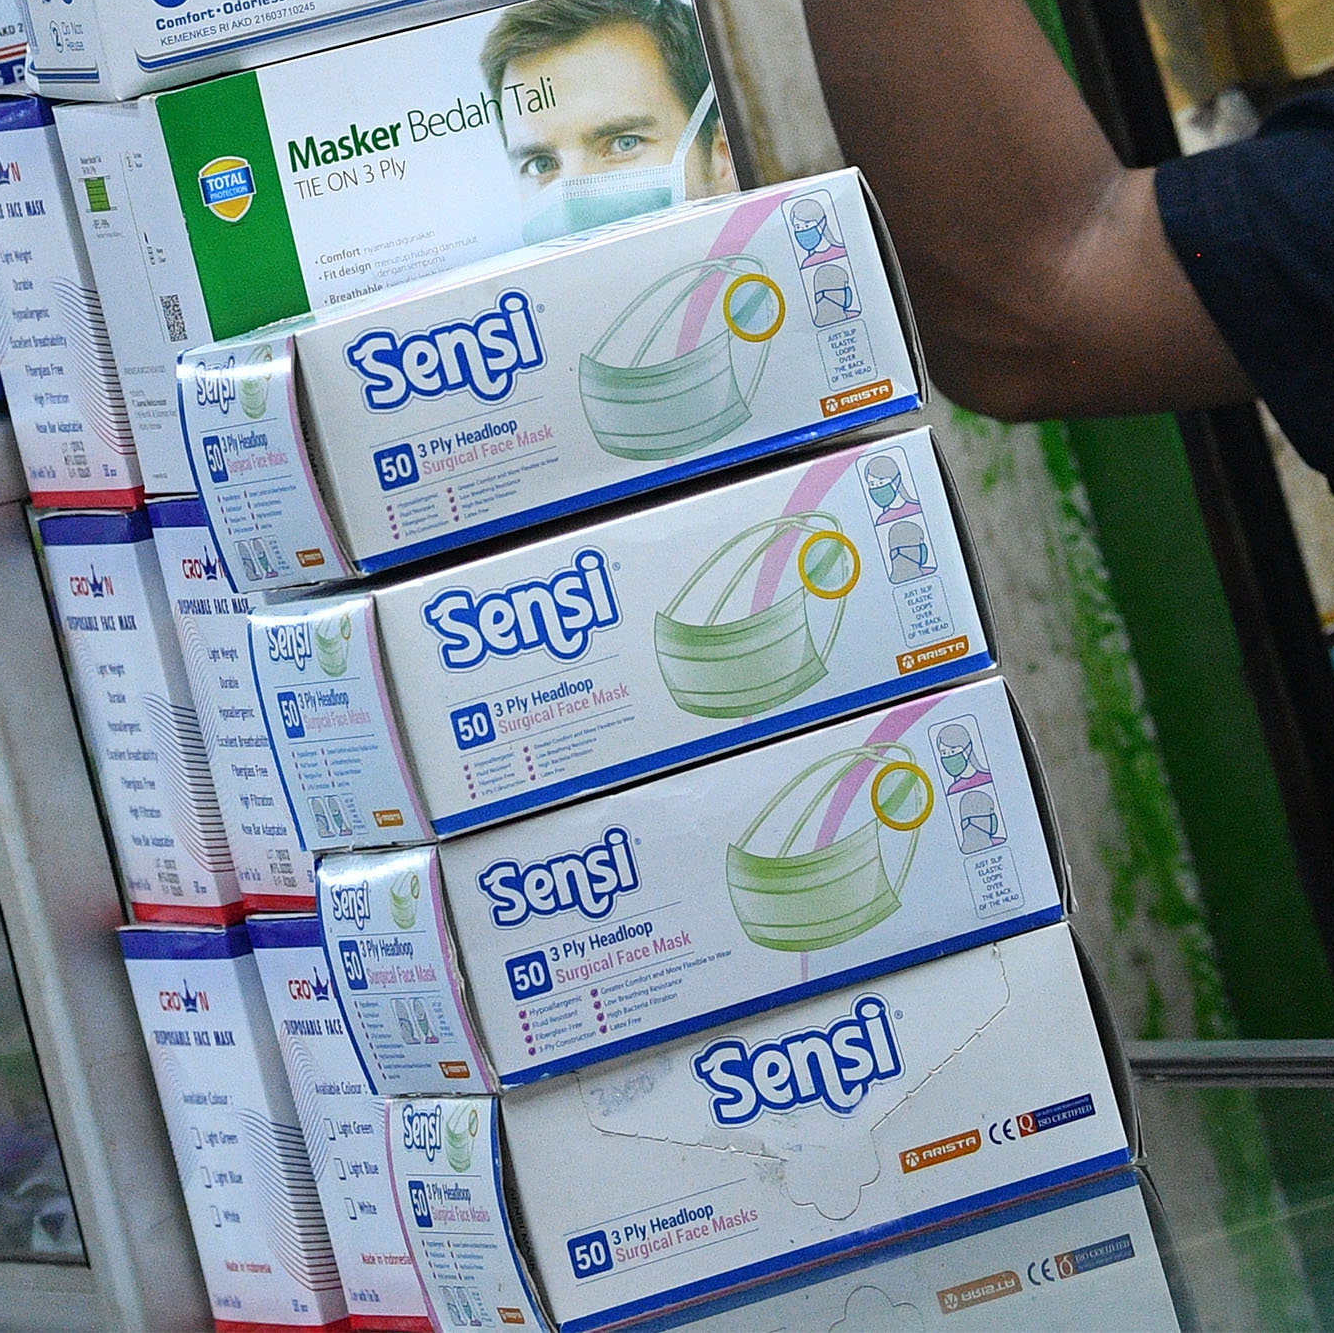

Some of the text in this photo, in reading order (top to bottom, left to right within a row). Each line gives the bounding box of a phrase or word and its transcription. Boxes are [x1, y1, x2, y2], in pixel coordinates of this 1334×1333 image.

[155, 7, 215, 31] Comfort
[160, 1, 316, 47] KEMENKES RI AKD 21603710245
[287, 76, 557, 174] Masker Bedah Tali
[205, 169, 247, 191] TOTAL
[209, 183, 249, 201] PROTECTION
[294, 156, 407, 200] TIE ON 3 Ply
[320, 247, 361, 265] Comfort
[323, 261, 372, 282] Fit design
[328, 282, 383, 306] Breathable
[346, 289, 547, 411] Sensi
[840, 385, 890, 406] ARISTA
[417, 418, 519, 458] 3 Ply Headloop
[422, 423, 555, 477] Surgical Face Mask
[380, 453, 414, 483] 50
[423, 546, 624, 670] Sensi
[917, 641, 965, 663] ARISTA
[493, 678, 594, 717] 3 Ply Headloop
[498, 682, 630, 735] Surgical Face Mask
[458, 711, 490, 743] 50
[479, 825, 643, 929] Sensi
[549, 921, 653, 962] 3 Ply Headloop
[556, 930, 692, 984] Surgical Face Mask
[513, 961, 546, 992] 50
[692, 994, 904, 1125] Sensi
[923, 1135, 977, 1161] ARISTA
[988, 1117, 1016, 1145] CE
[611, 1203, 714, 1246] 3 Ply Headloop
[615, 1208, 758, 1264] Surgical Face Masks
[574, 1241, 606, 1270] 50
